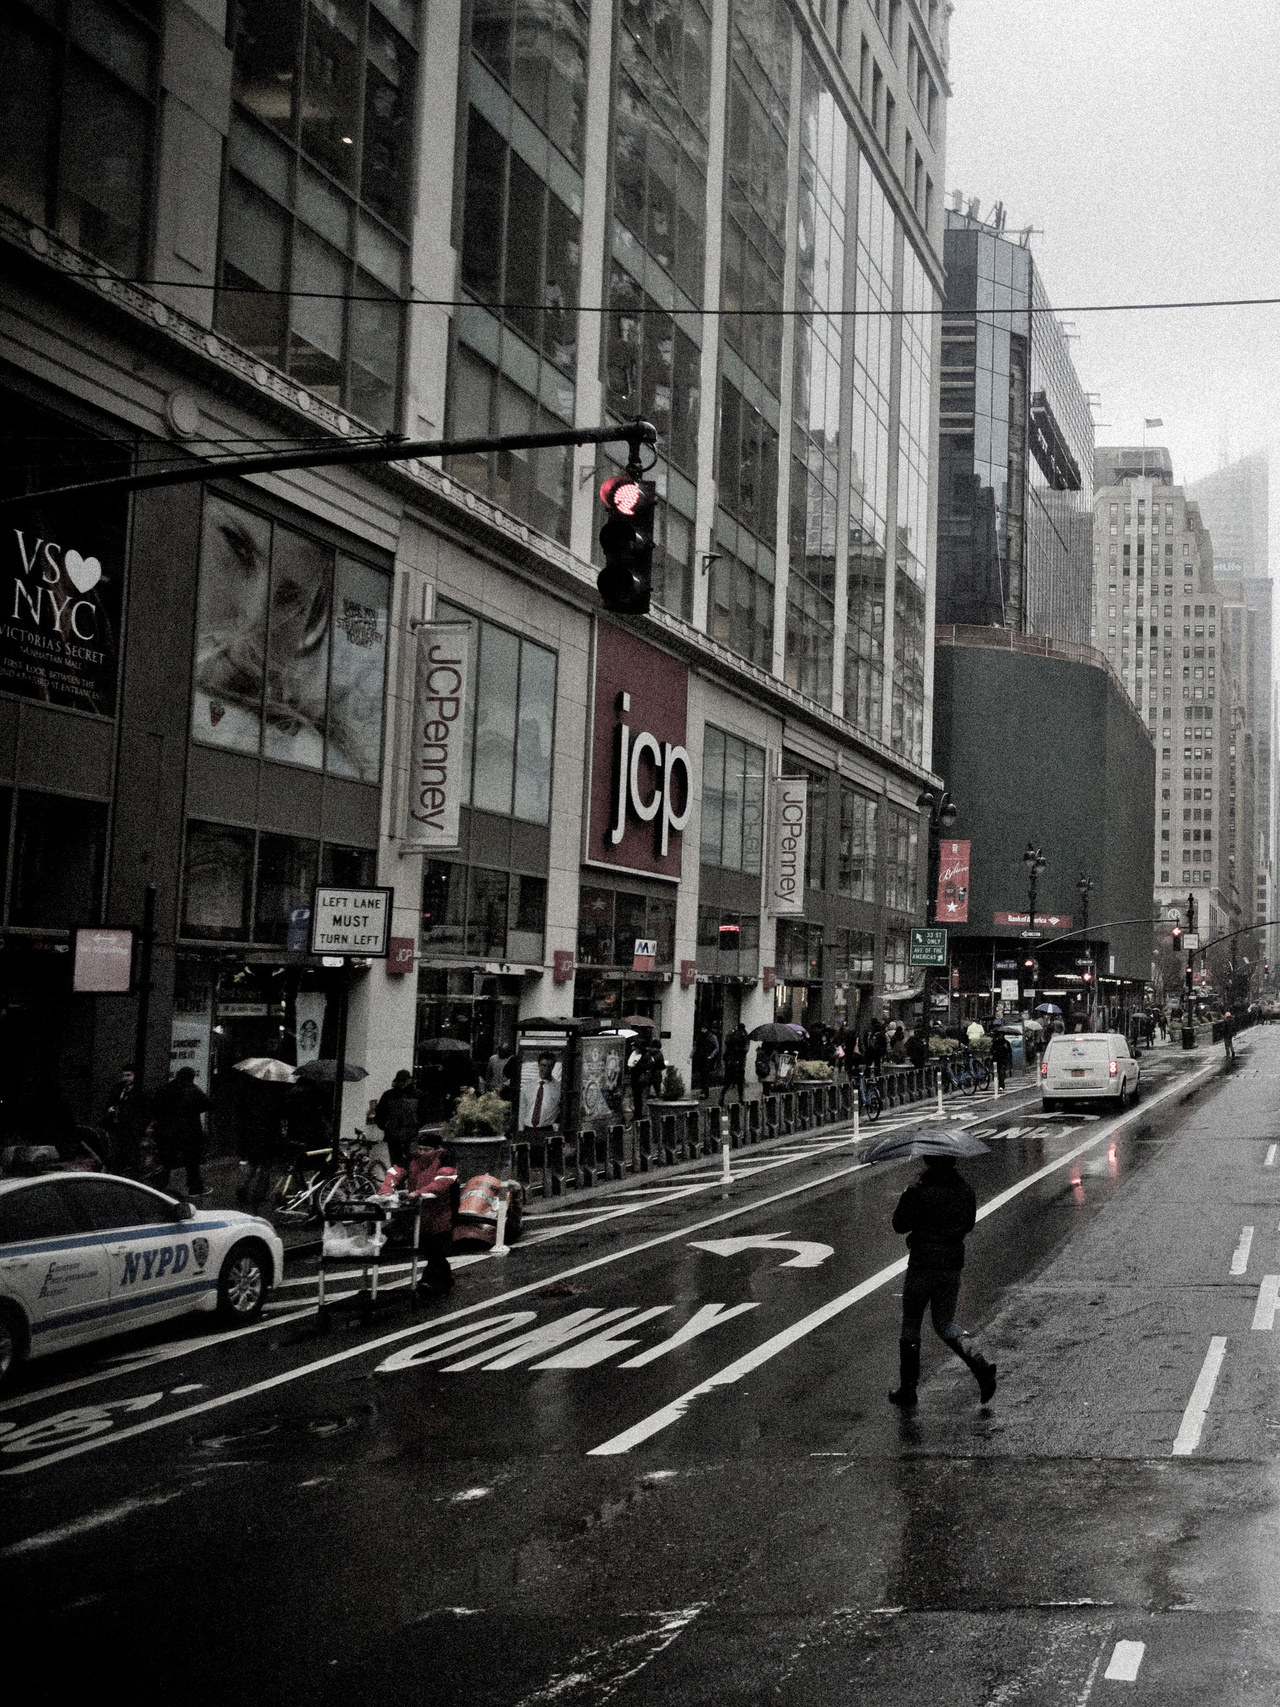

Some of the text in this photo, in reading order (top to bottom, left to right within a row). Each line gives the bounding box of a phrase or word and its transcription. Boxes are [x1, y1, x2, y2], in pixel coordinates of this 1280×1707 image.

[12, 528, 62, 584] VS
[1213, 562, 1242, 571] etLife
[11, 577, 97, 641] NYC
[65, 641, 106, 665] SECRET
[411, 644, 462, 831] JCPenney
[612, 691, 693, 857] jcp
[775, 791, 804, 904] JCPenney
[322, 897, 382, 909] LEFT LANE
[332, 915, 370, 928] MUST
[320, 933, 379, 946] TURN LEFT
[395, 948, 413, 962] JCP
[120, 1243, 190, 1286] NYPD
[373, 1302, 762, 1372] ONLY
